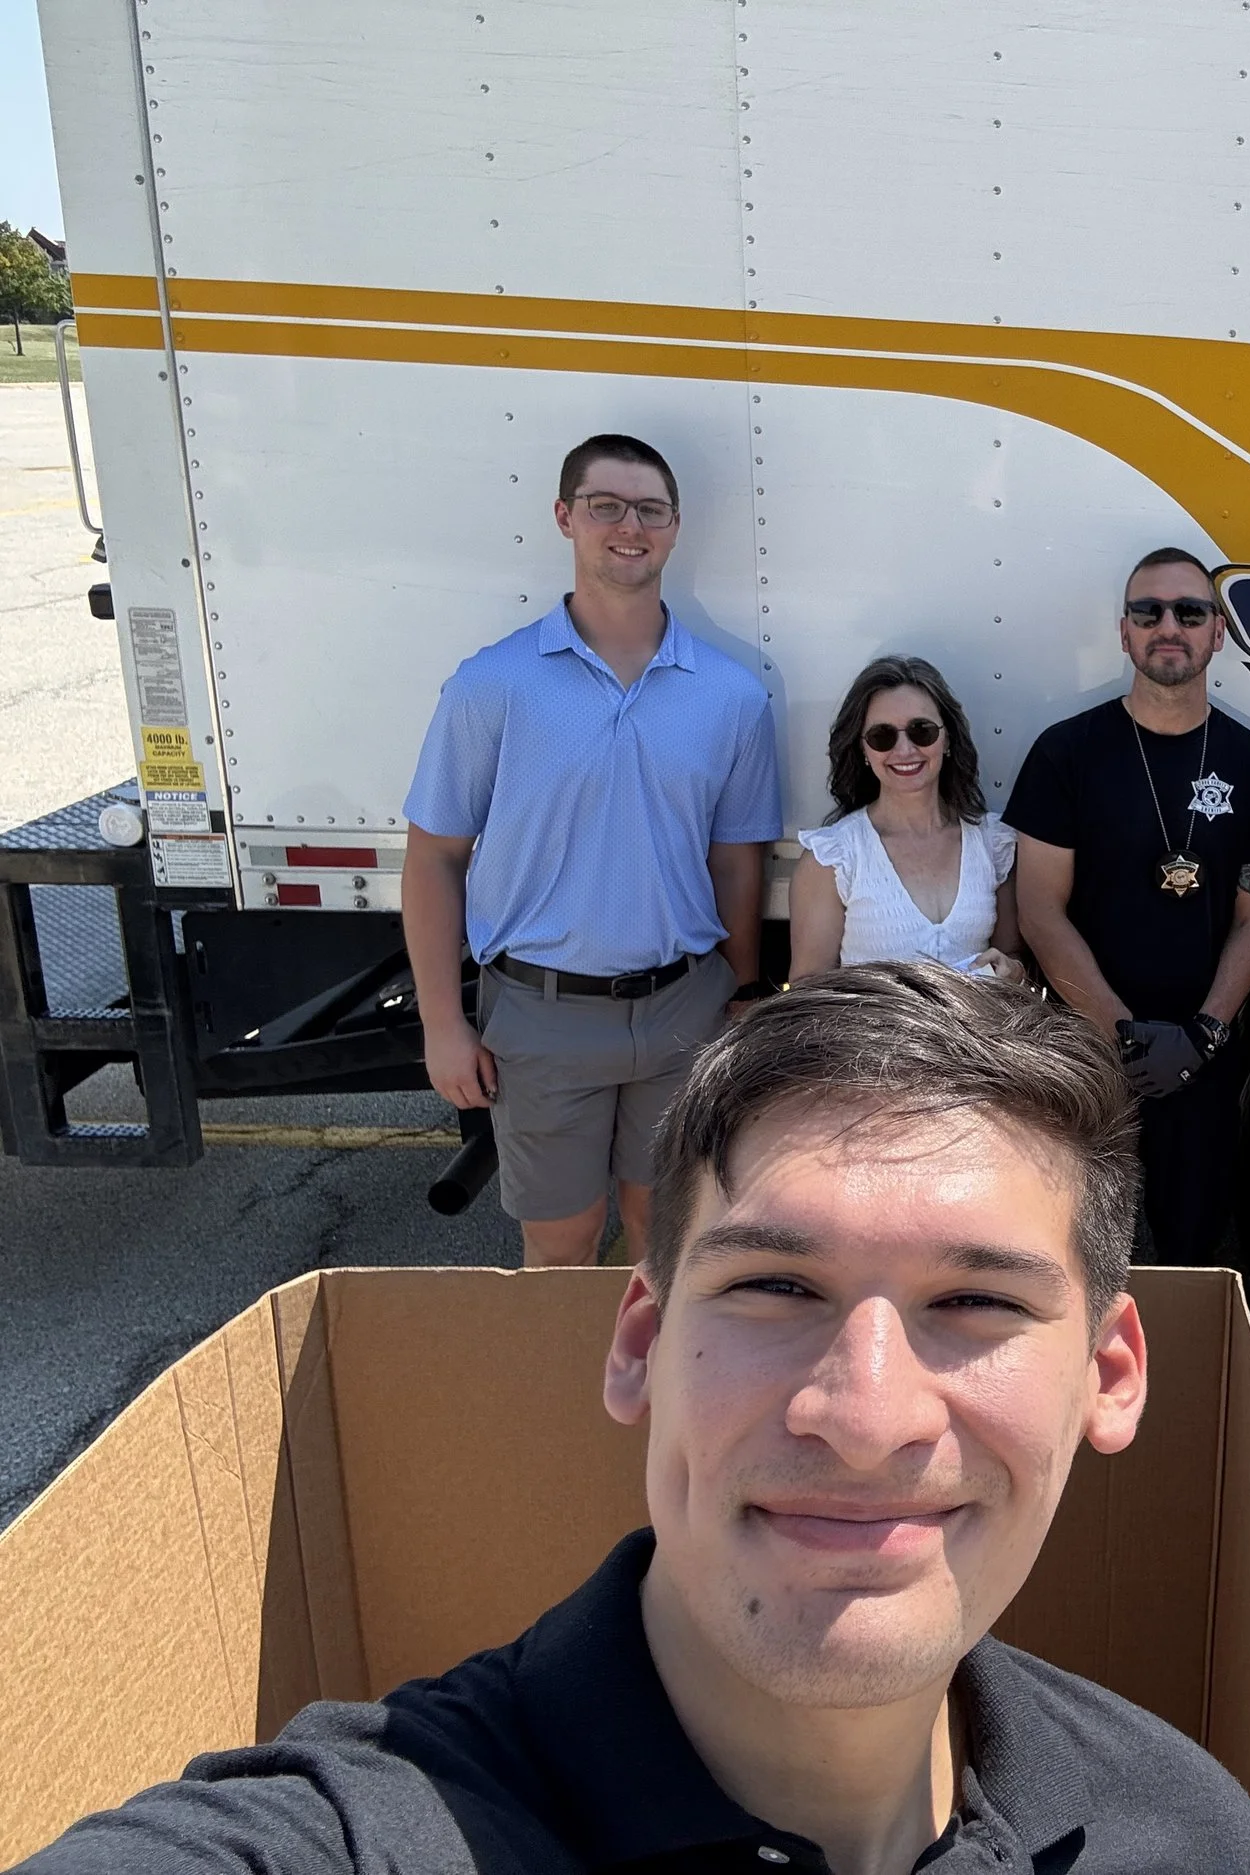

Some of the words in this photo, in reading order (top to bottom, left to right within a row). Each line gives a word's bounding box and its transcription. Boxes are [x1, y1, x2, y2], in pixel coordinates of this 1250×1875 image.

[147, 733, 172, 744] 4000
[175, 734, 188, 745] lb.
[154, 792, 198, 800] NOTICE
